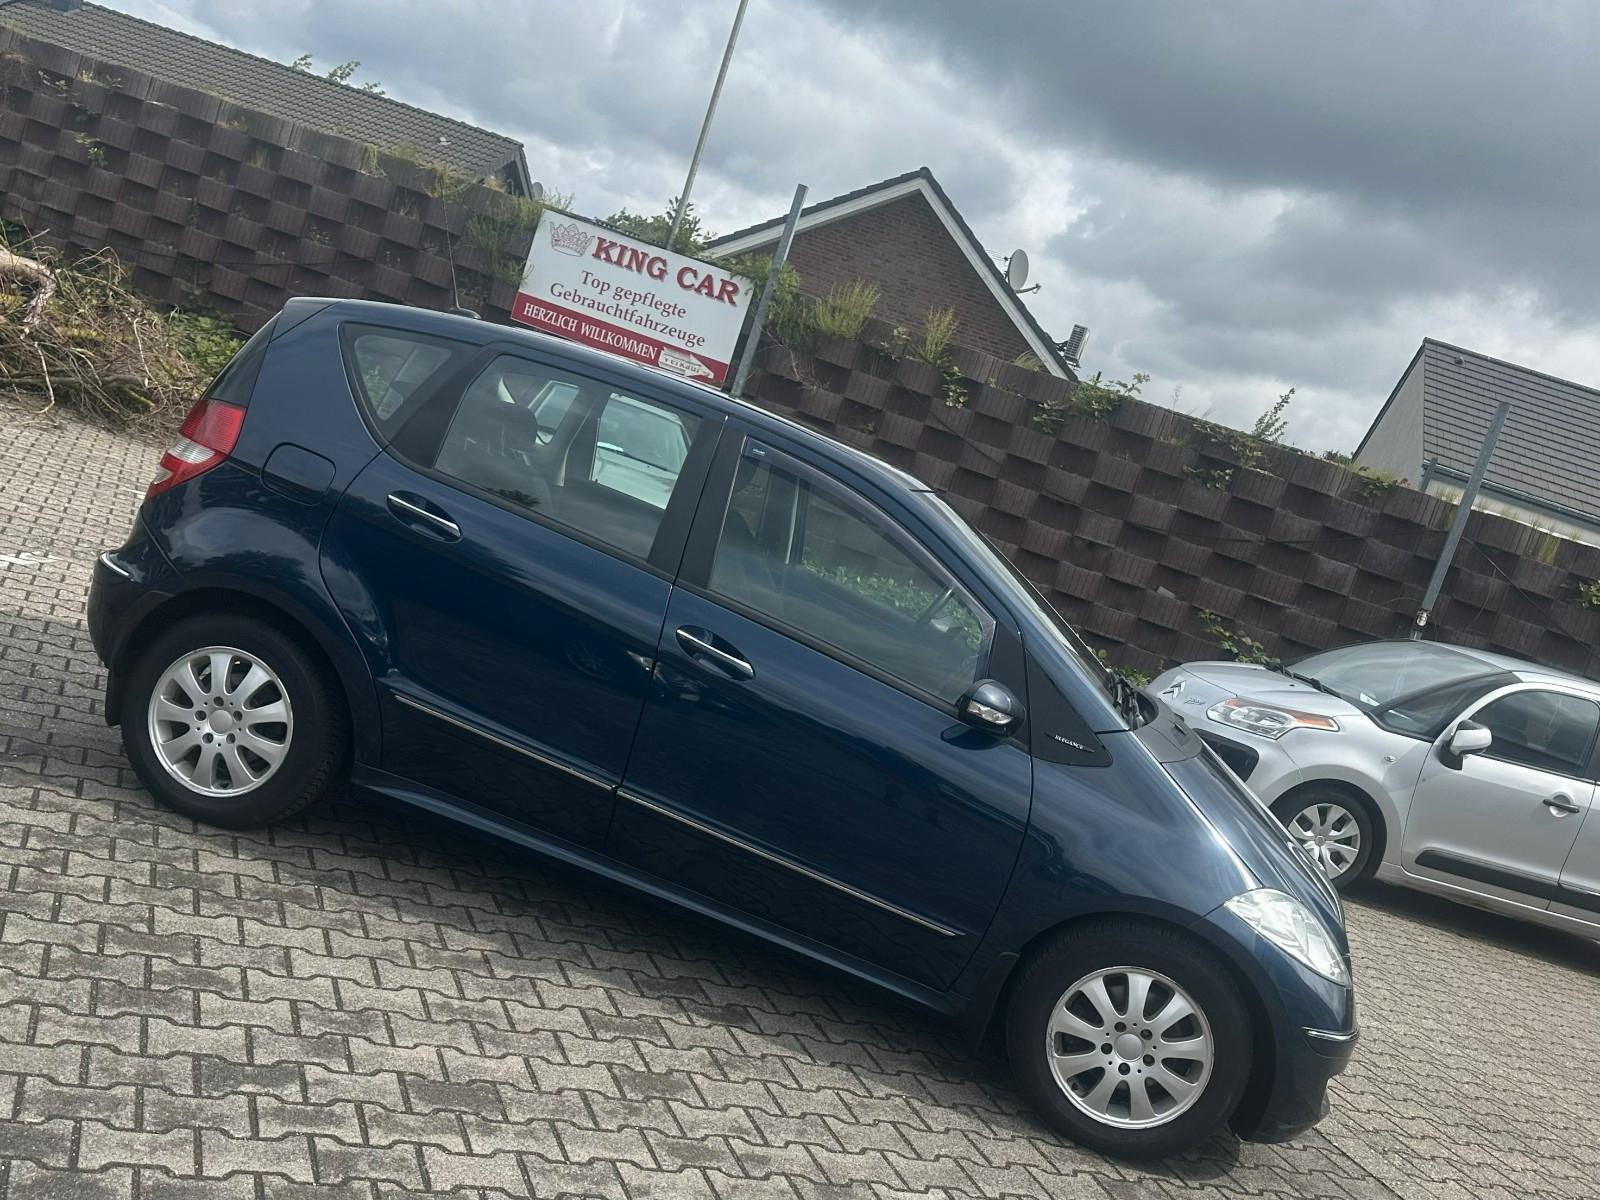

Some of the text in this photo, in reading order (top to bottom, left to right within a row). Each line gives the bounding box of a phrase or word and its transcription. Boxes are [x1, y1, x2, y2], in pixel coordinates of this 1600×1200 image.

[581, 270, 687, 318] Top gepflegte
[592, 236, 740, 306] KING CAR
[523, 302, 658, 360] HERZLICH WILLKOMMEN
[550, 282, 705, 348] Gebrauchtfahrzeuge
